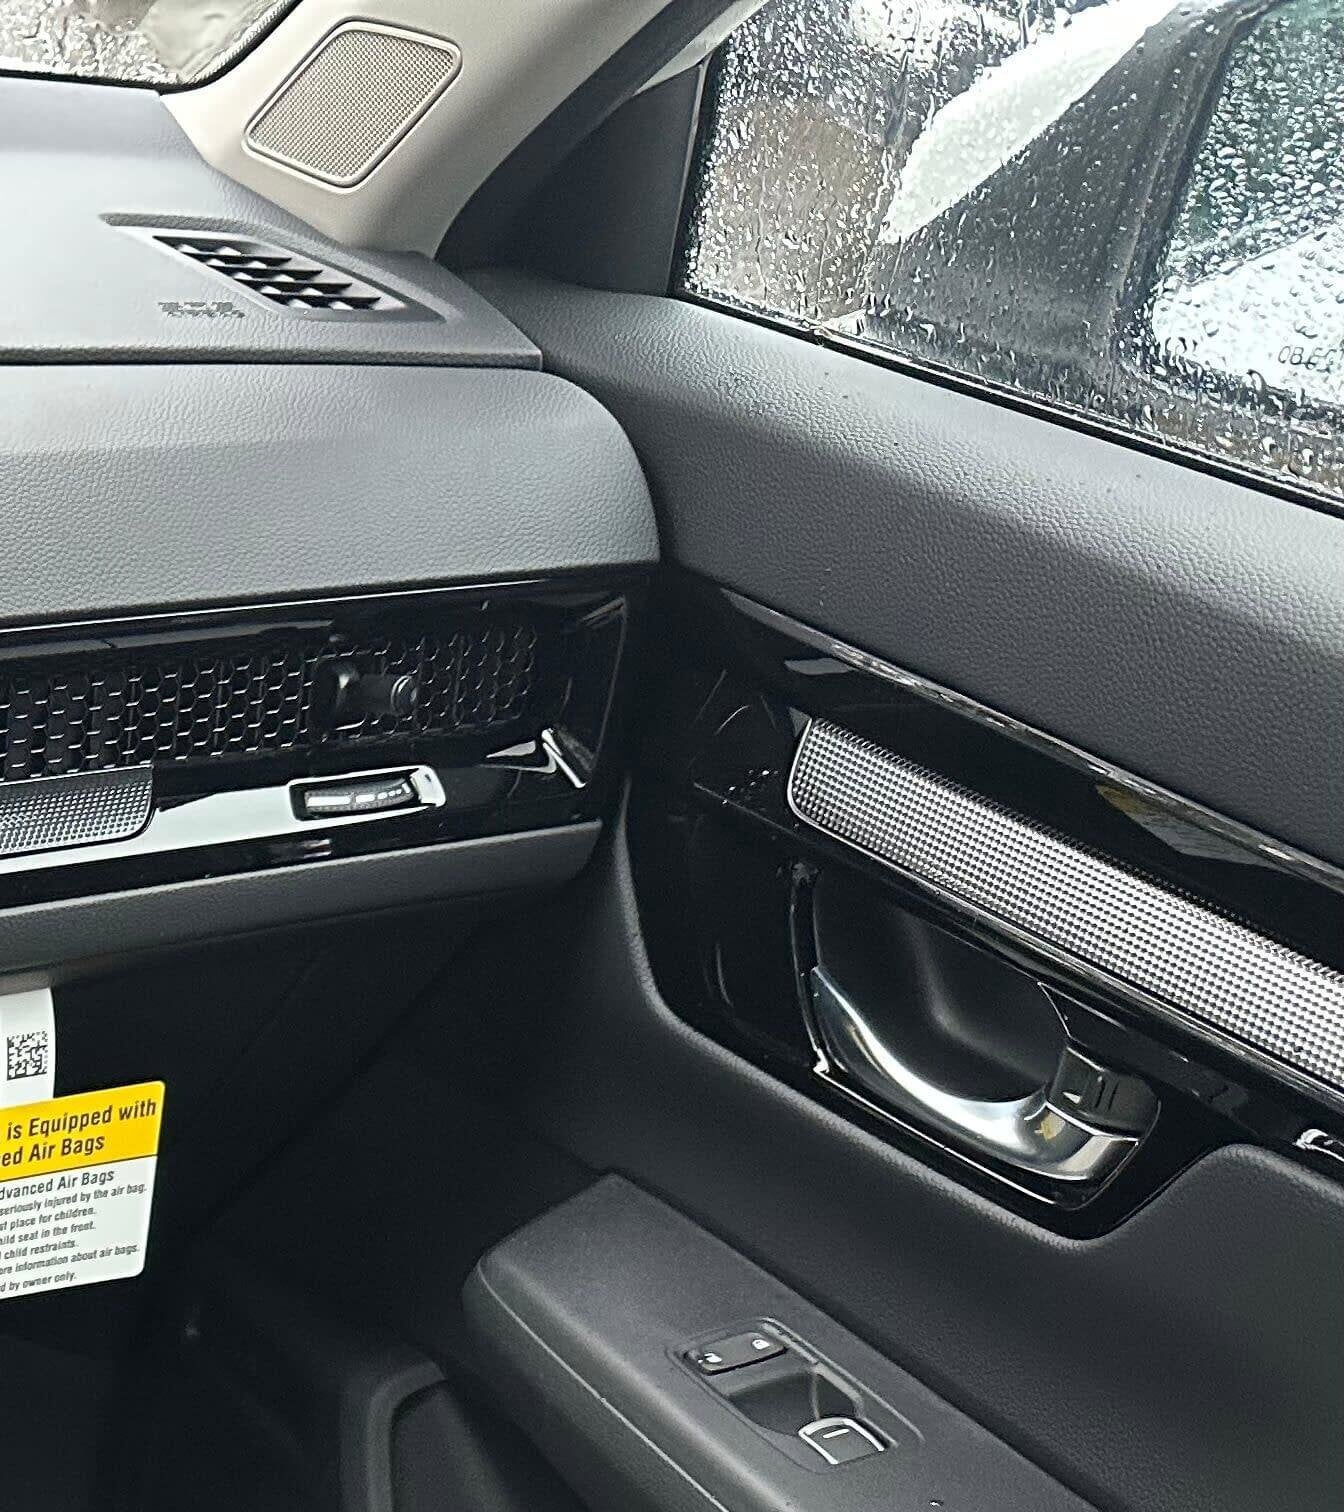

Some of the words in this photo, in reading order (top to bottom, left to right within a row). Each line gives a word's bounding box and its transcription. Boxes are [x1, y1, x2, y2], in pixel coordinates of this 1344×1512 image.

[6, 1121, 22, 1140] is
[28, 1105, 113, 1137] Equipped
[118, 1098, 156, 1121] with
[28, 1142, 56, 1162] Air
[60, 1136, 105, 1156] Bags
[56, 1175, 78, 1191] Air
[80, 1170, 115, 1186] Bags
[0, 1200, 42, 1216] seriously
[44, 1193, 77, 1208] injured
[80, 1192, 91, 1203] by
[94, 1189, 108, 1199] the
[111, 1186, 125, 1197] air
[10, 1217, 36, 1231] place
[39, 1213, 52, 1225] for
[18, 1230, 38, 1242] seat
[41, 1228, 50, 1239] in
[53, 1226, 68, 1236] the
[4, 1247, 28, 1260] child
[15, 1255, 69, 1273] information
[71, 1250, 98, 1263] about
[99, 1247, 113, 1258] air
[9, 1281, 20, 1292] by
[22, 1275, 53, 1289] owner
